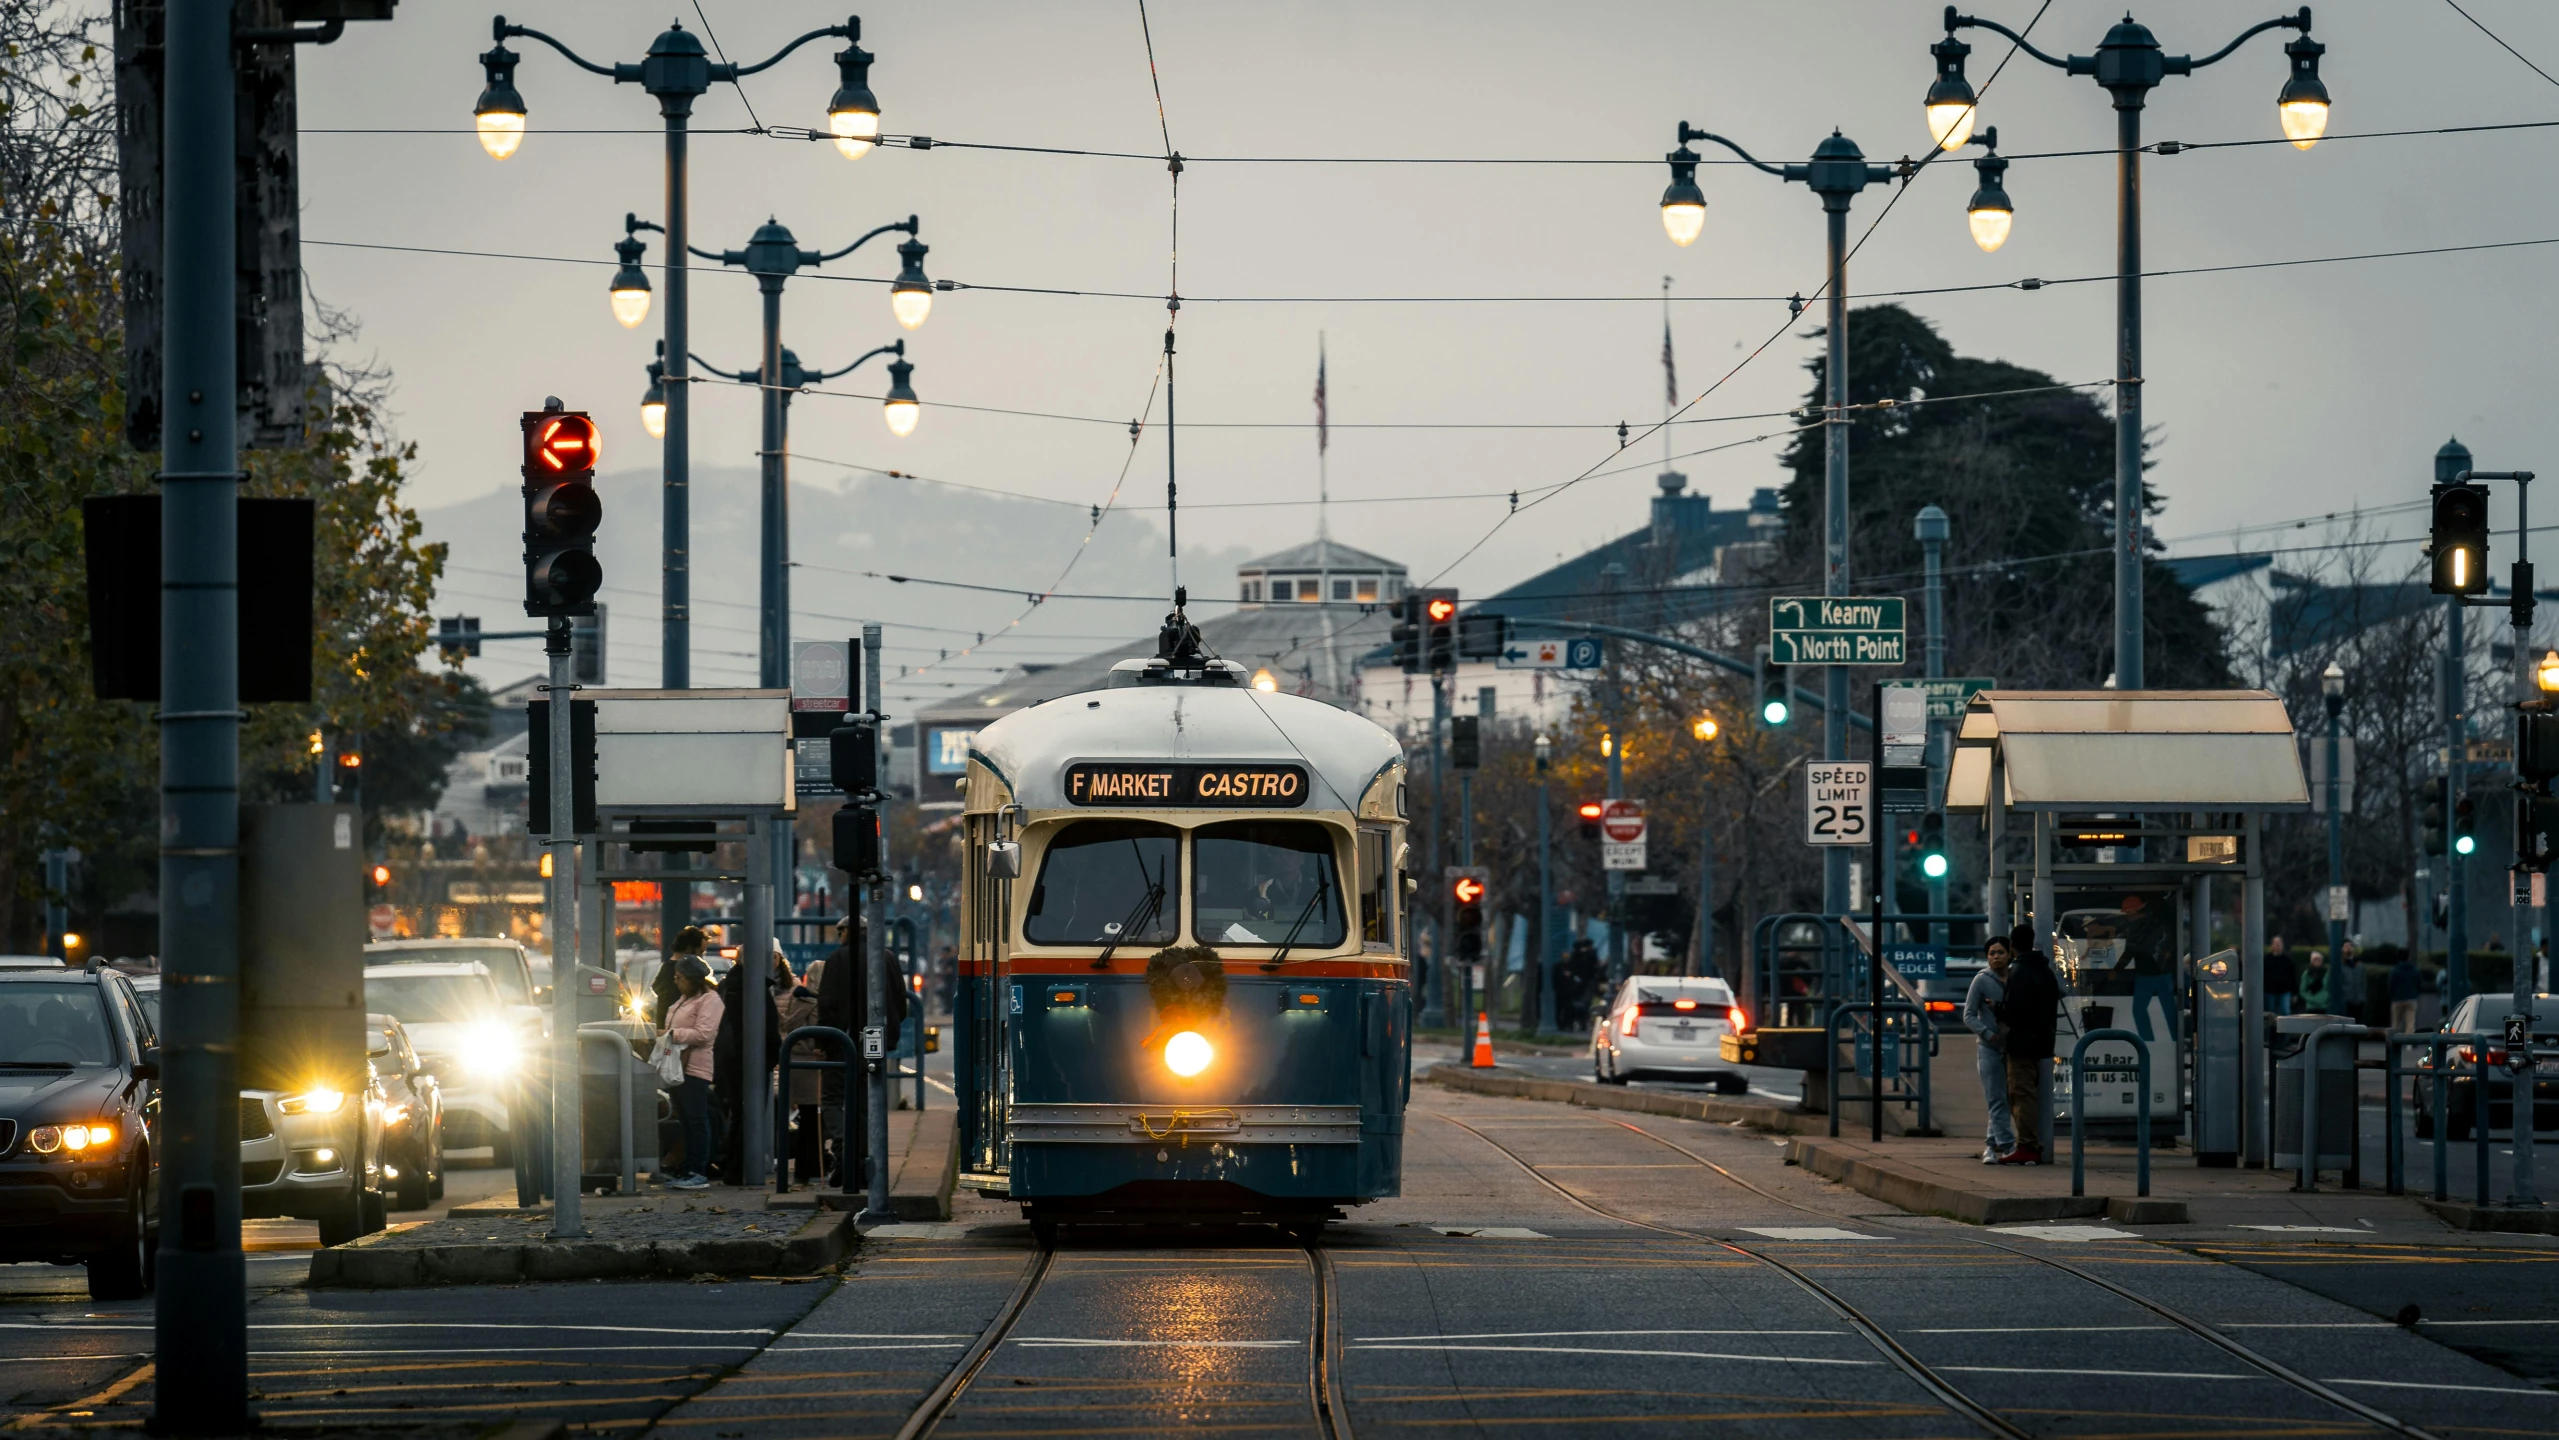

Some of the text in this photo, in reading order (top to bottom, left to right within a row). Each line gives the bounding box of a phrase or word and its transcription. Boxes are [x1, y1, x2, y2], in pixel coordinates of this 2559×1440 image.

[1821, 600, 1882, 629] Kearny
[1802, 636, 1900, 659] North Point
[802, 698, 841, 708] streetcar
[1926, 701, 1950, 715] rth
[797, 740, 806, 754] F
[1883, 746, 1893, 757] F
[799, 768, 805, 778] L
[1811, 771, 1867, 784] SPEED
[1073, 774, 1298, 797] F MARKET CASTRO
[1817, 788, 1860, 801] LIMIT
[1813, 805, 1865, 835] 25
[1894, 951, 1936, 961] BACK
[1898, 963, 1937, 974] EDGE
[2054, 1070, 2098, 1083] wiin
[2101, 1072, 2116, 1083] us
